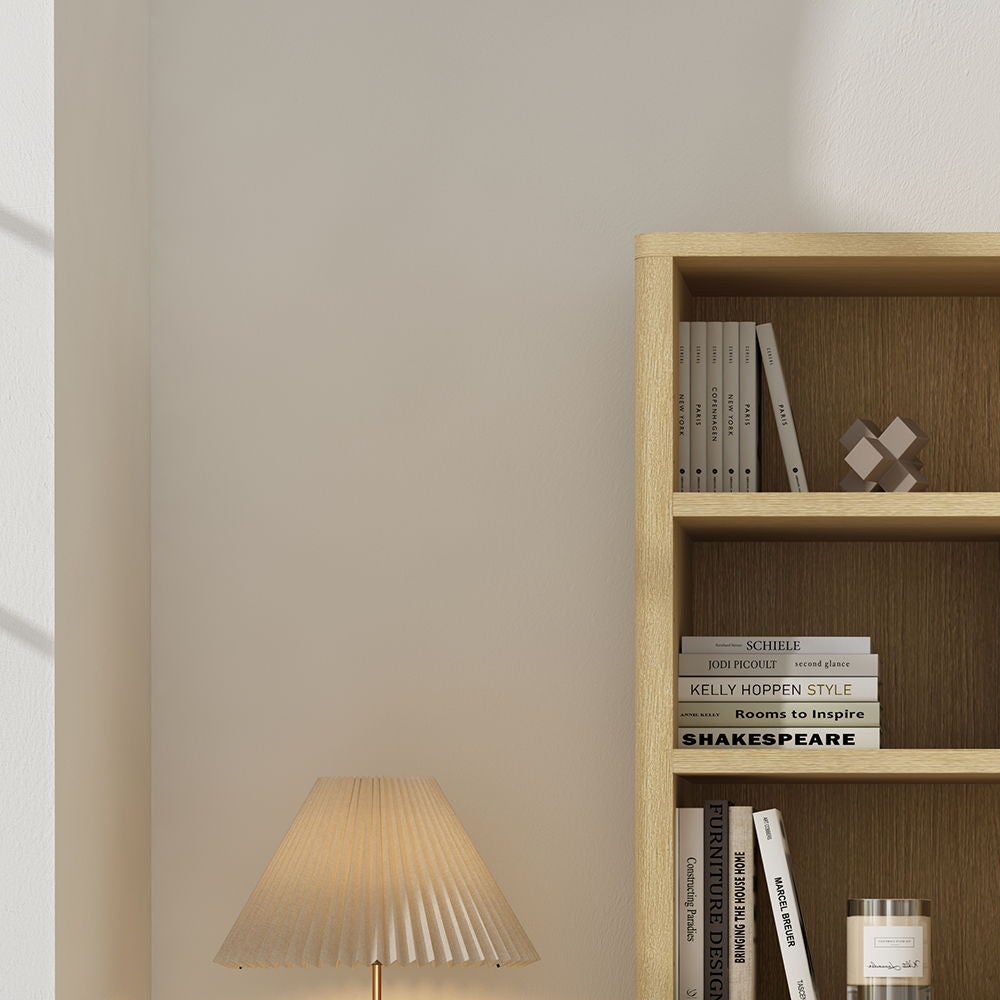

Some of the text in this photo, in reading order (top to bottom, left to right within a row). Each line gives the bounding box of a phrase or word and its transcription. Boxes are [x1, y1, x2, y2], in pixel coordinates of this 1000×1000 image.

[778, 404, 788, 426] PARIS
[746, 640, 801, 651] SCHIELE
[707, 660, 778, 671] JODI PICOULT
[794, 660, 851, 669] second glance
[690, 684, 852, 696] KELLY HOPPEN STYLE
[735, 709, 865, 721] Rooms to Inspire
[682, 733, 856, 746] SHAKESPEARE
[709, 804, 723, 924] FURNITURE
[685, 857, 698, 942] Constructing Paradies
[734, 851, 745, 964] BRINGING THE HOUSE HOME
[774, 876, 796, 948] MARCEL BREUER
